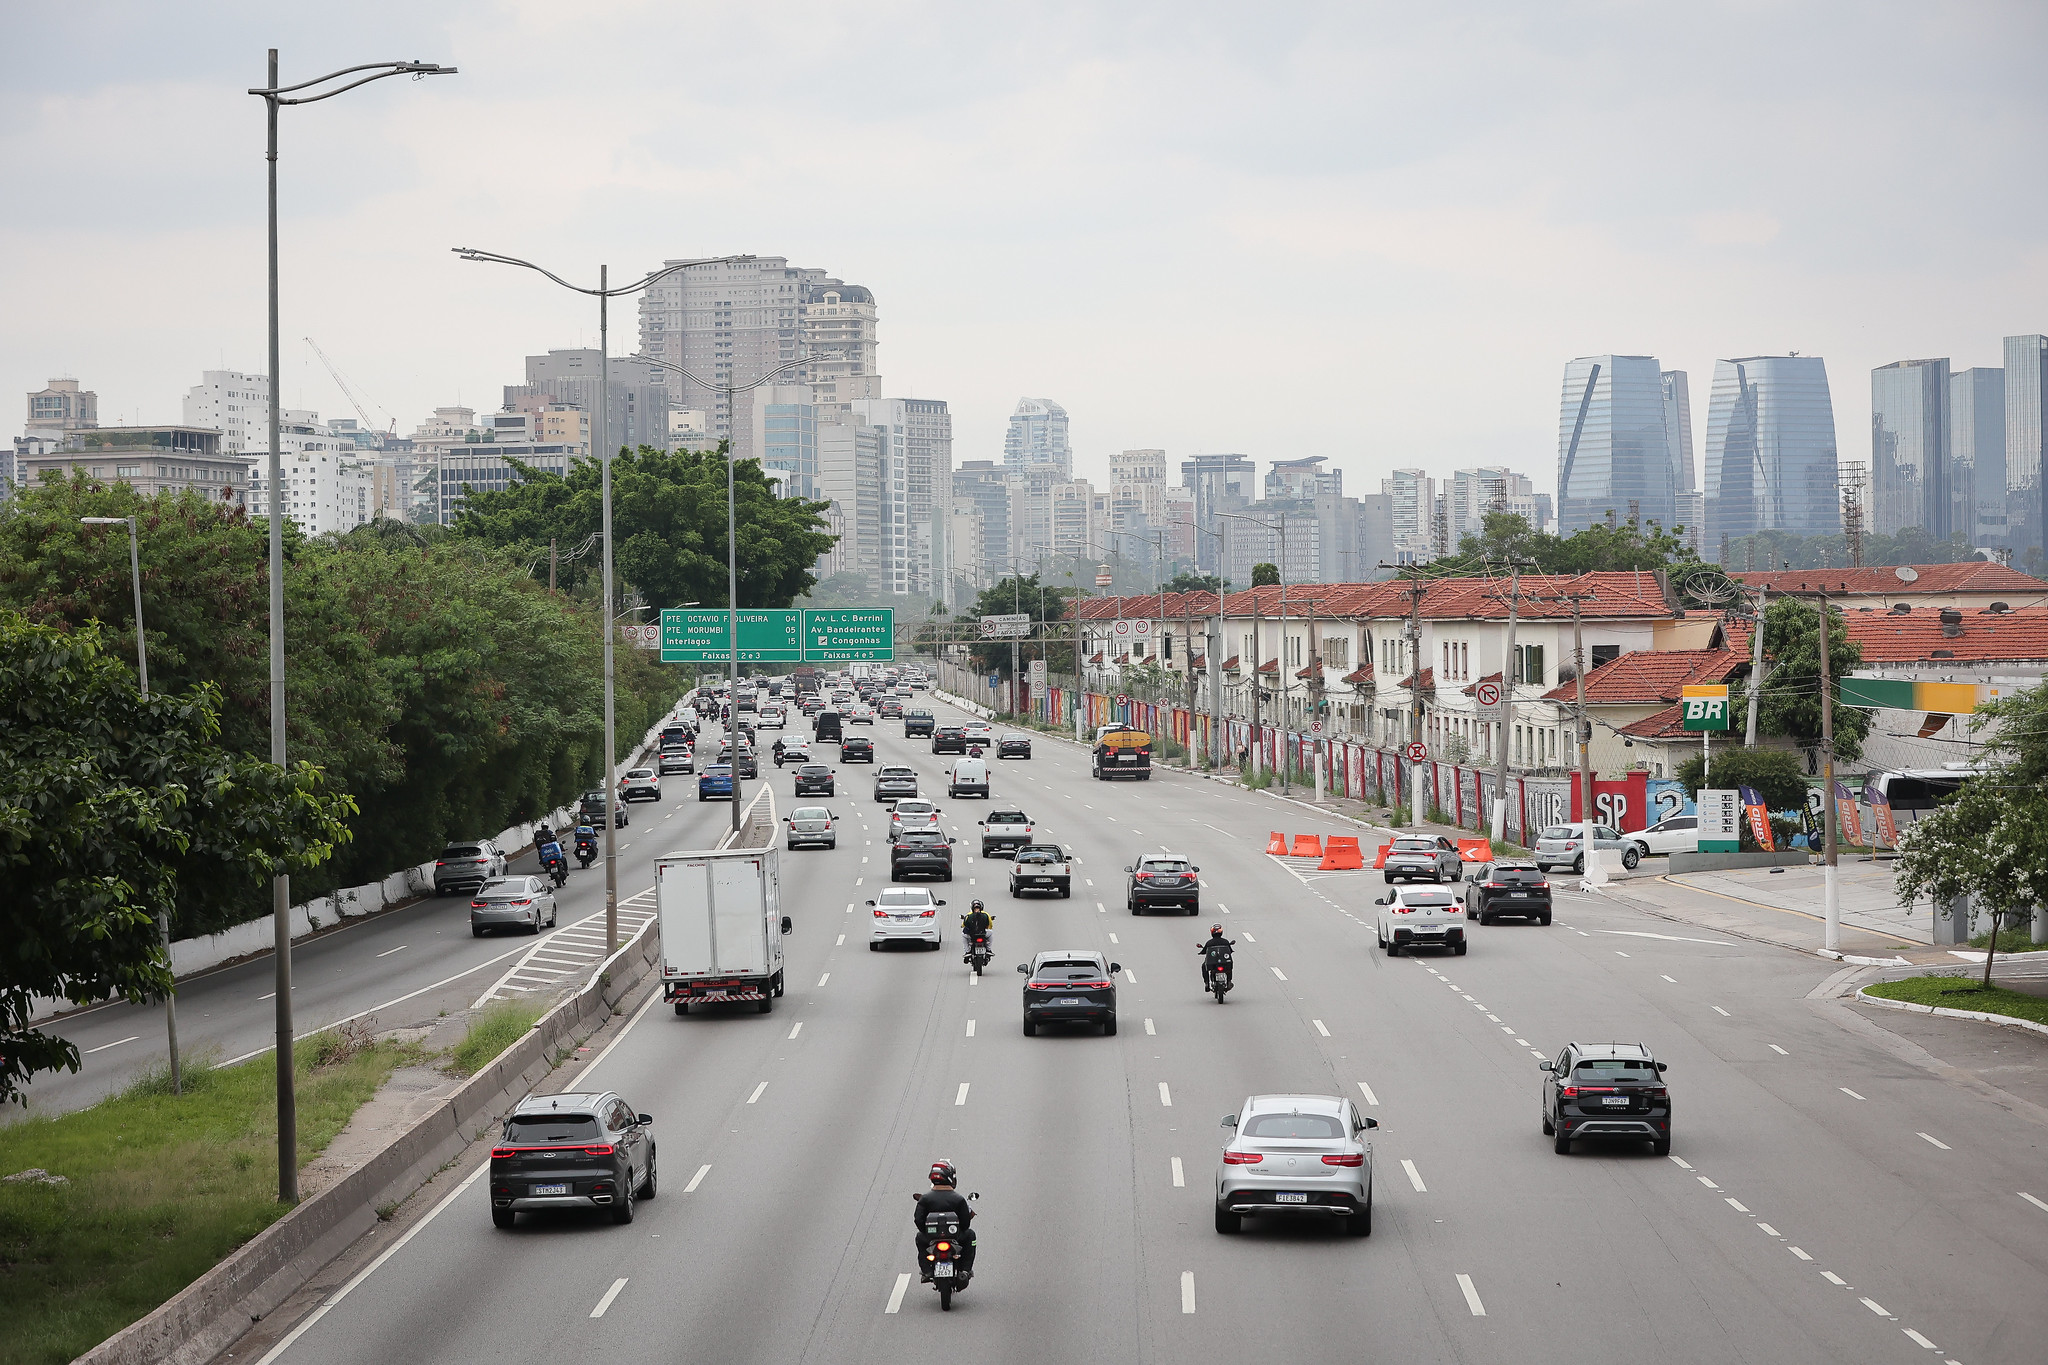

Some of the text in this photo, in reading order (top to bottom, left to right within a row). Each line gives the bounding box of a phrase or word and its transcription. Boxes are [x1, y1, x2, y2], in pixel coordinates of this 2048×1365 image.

[666, 615, 683, 623] PTE.
[687, 615, 719, 623] OCTAVIO
[785, 615, 796, 623] 04
[852, 614, 883, 622] Berrini
[666, 626, 683, 634] PTE.
[687, 626, 723, 634] MORUMBI
[666, 638, 711, 647] Interlagos
[832, 637, 881, 645] Congonhas
[702, 652, 730, 660] Faixas
[755, 652, 761, 660] 3
[853, 651, 860, 659] 4
[868, 651, 875, 659] 5
[1686, 700, 1723, 720] BR
[1595, 792, 1627, 832] SP
